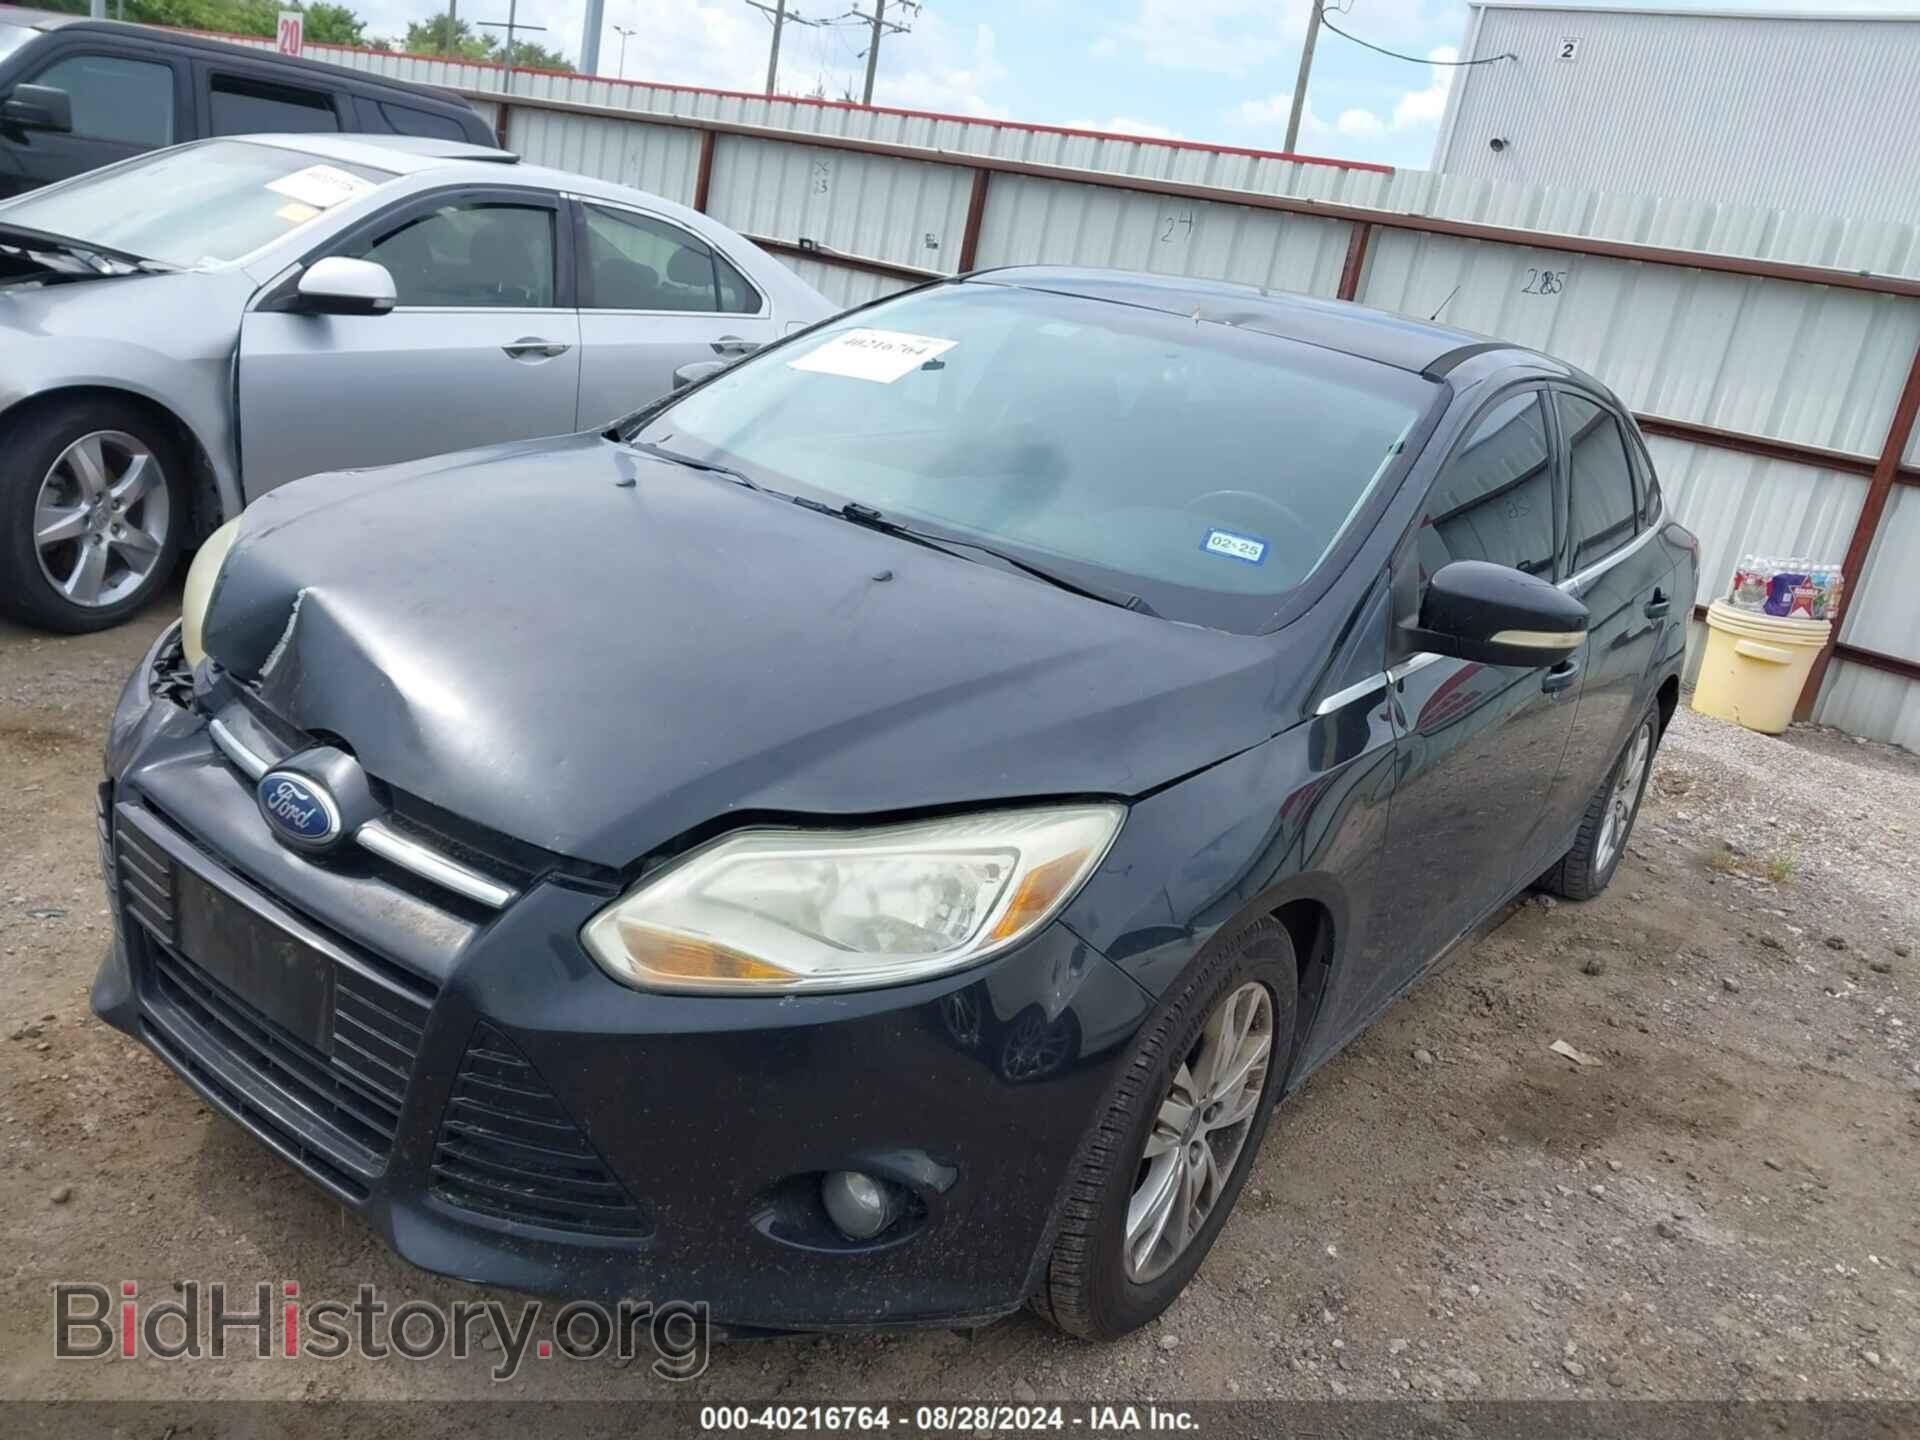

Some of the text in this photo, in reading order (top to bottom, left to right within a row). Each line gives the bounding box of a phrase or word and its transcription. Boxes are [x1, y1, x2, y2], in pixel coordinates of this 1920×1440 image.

[279, 18, 300, 55] 20
[1561, 43, 1574, 58] 2
[1160, 210, 1193, 243] 24
[1238, 543, 1259, 556] 25
[267, 781, 317, 829] Ford
